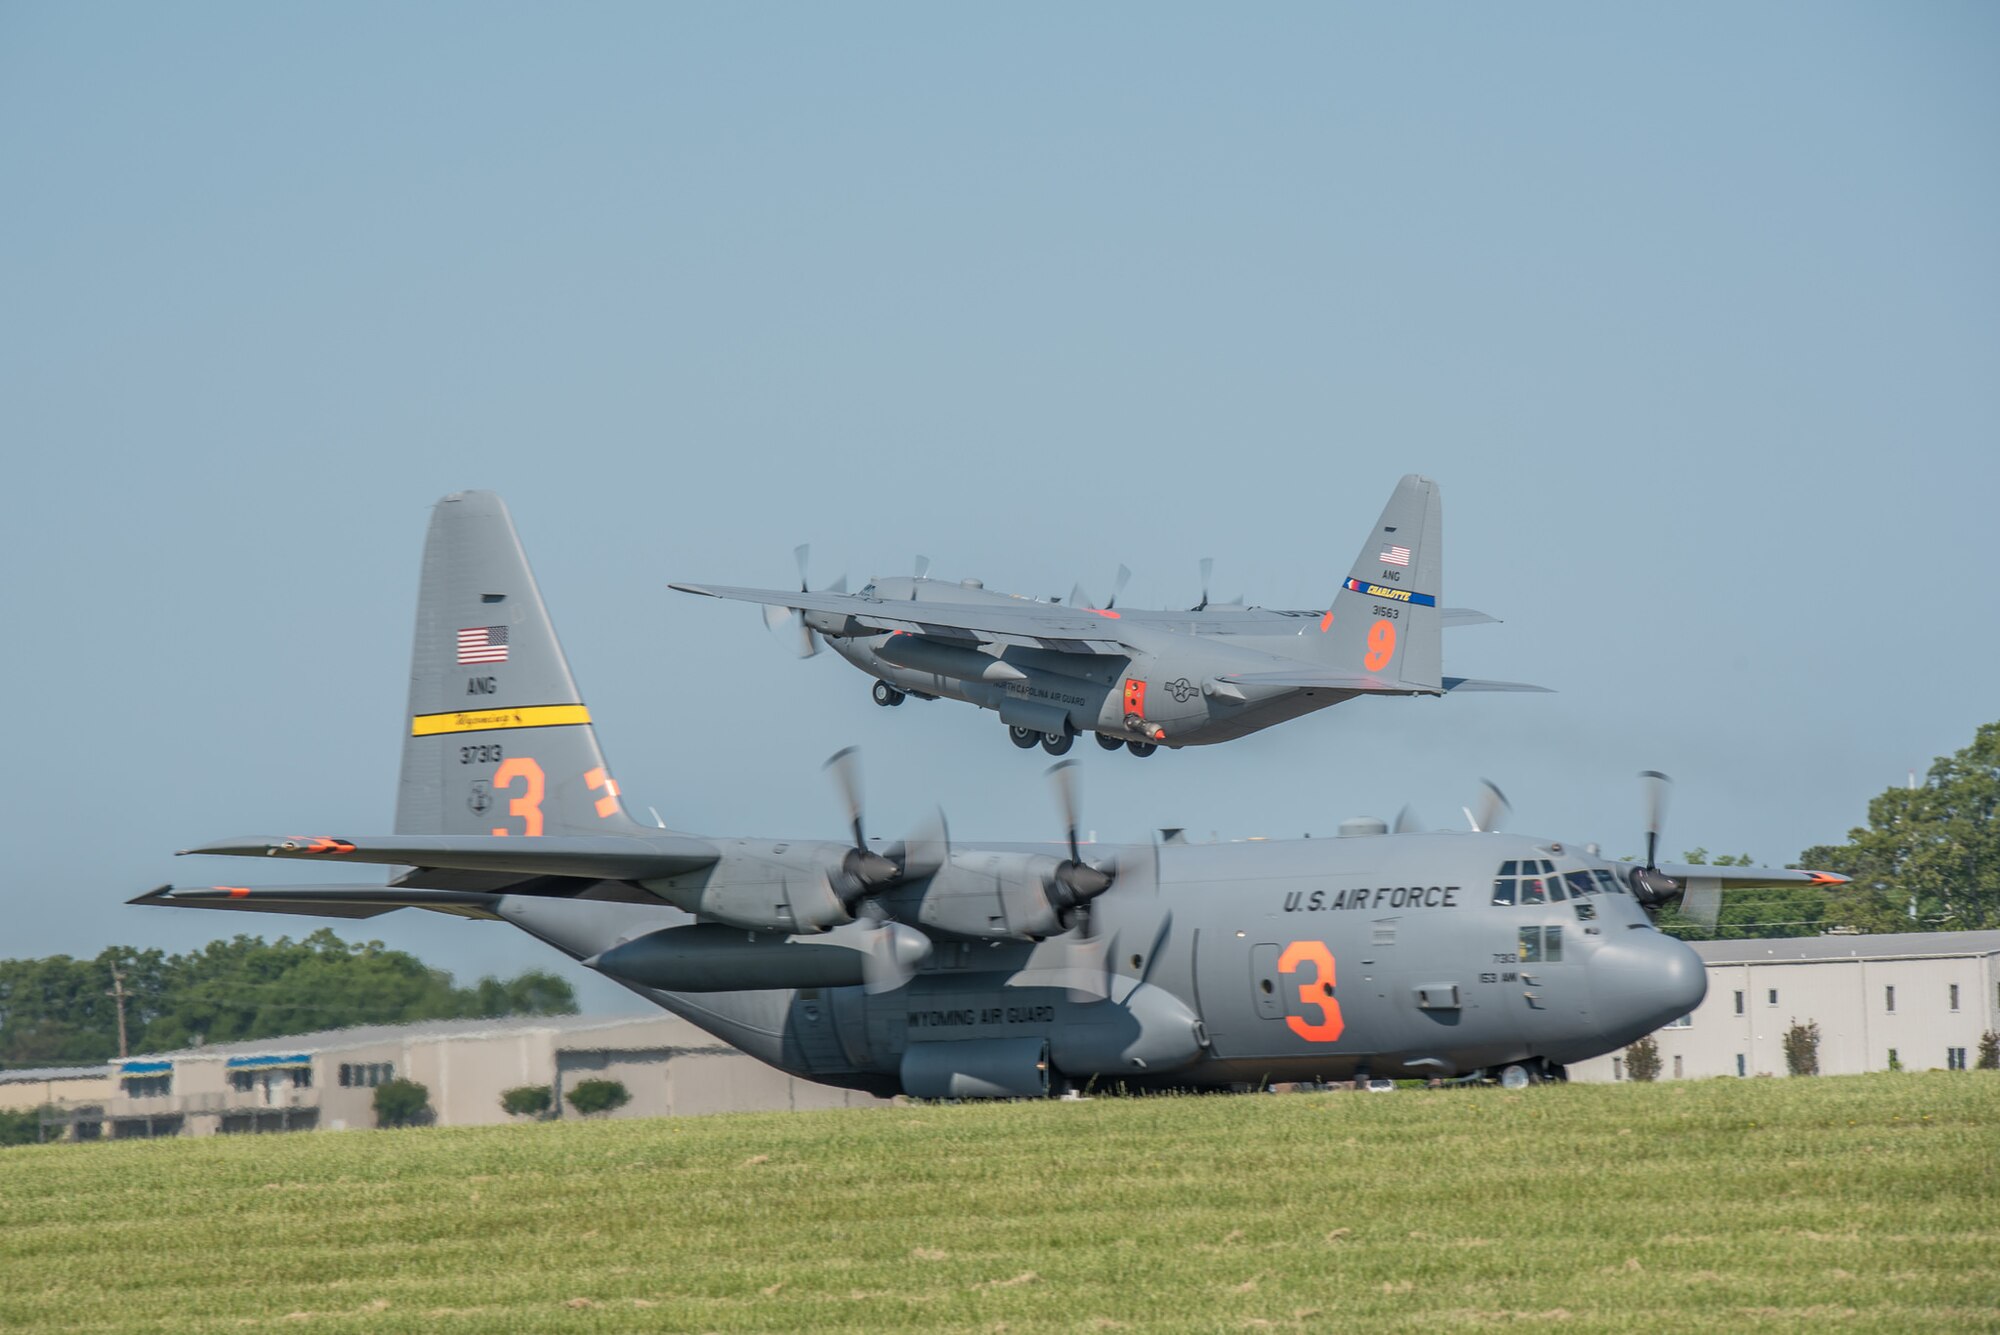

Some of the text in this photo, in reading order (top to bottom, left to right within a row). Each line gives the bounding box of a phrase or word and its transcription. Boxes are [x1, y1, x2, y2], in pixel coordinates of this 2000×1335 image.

[1382, 570, 1401, 582] ANG
[1367, 585, 1412, 602] CHARLOTTE
[1372, 605, 1399, 619] 31563
[1364, 619, 1396, 672] 9
[466, 676, 497, 695] ANG
[1050, 691, 1062, 700] AIR
[1062, 694, 1086, 706] GUARD
[460, 744, 502, 765] 37313
[492, 757, 545, 836] 3
[1283, 886, 1461, 912] U.S. AIR FORCE
[1277, 940, 1345, 1042] 3
[907, 1005, 1055, 1027] WYOMING AIR GUARD
